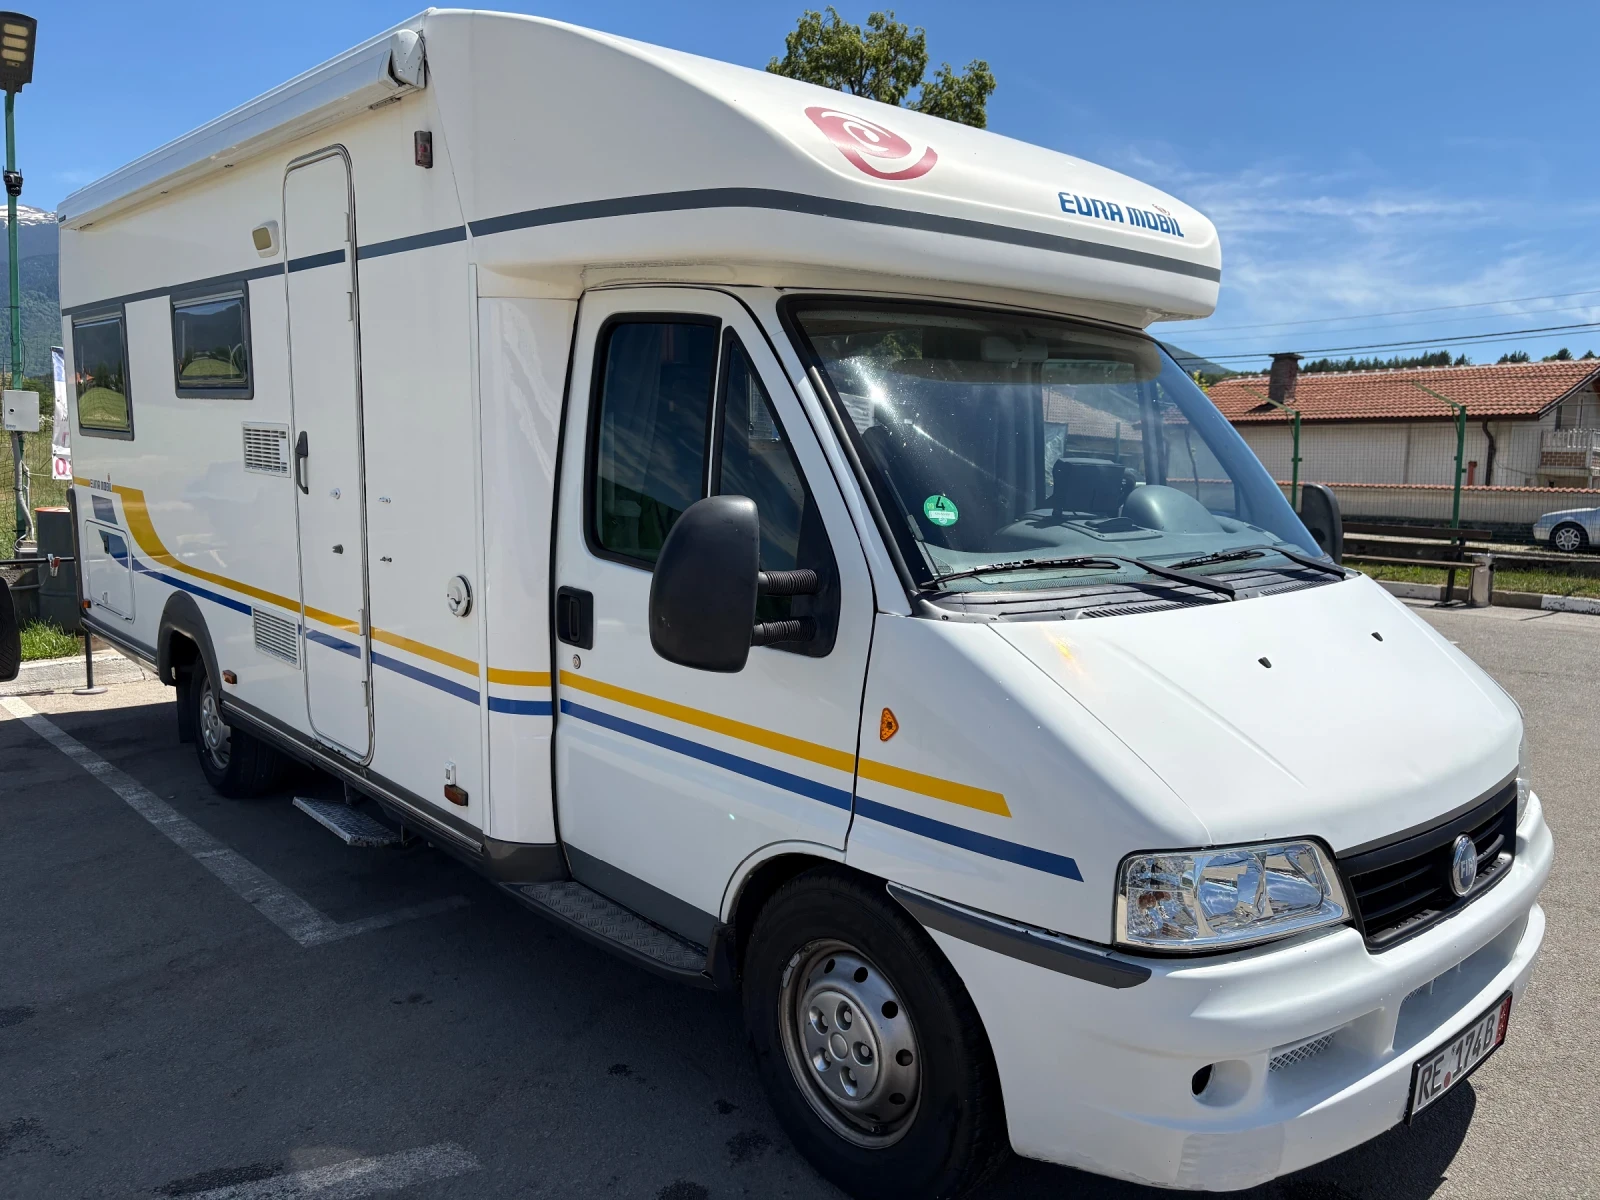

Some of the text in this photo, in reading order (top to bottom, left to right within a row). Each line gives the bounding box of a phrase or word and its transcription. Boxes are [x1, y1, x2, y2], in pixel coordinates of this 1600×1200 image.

[1058, 191, 1185, 238] EURA MOBIL
[935, 496, 945, 510] 4
[1417, 1055, 1444, 1105] RE
